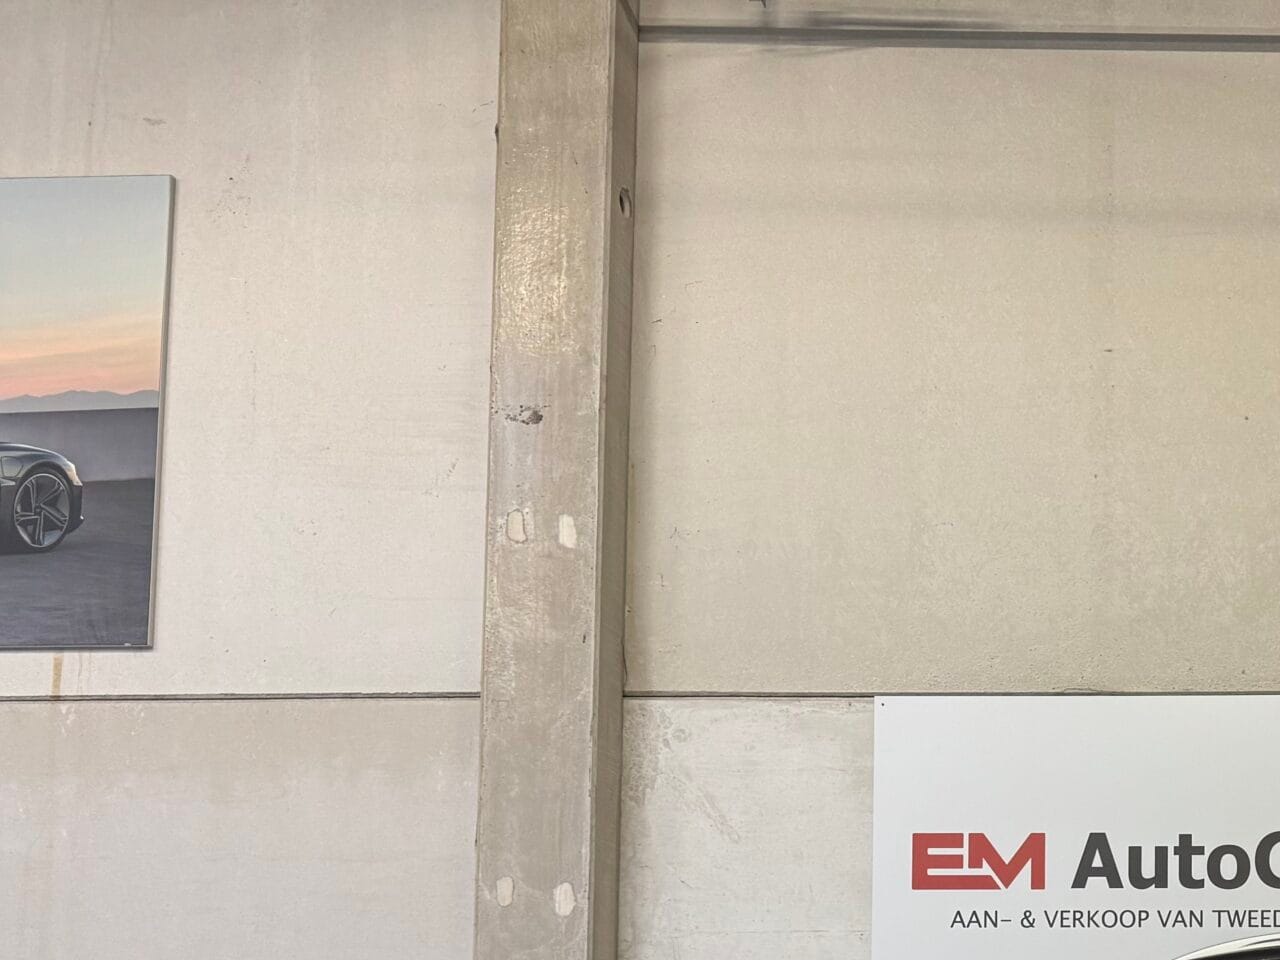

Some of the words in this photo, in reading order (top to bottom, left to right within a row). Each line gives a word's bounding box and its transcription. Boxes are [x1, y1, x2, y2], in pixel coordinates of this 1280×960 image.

[912, 832, 1046, 890] EM
[1020, 910, 1036, 928] &
[1044, 909, 1149, 928] VERKOOP
[1157, 909, 1203, 928] VAN
